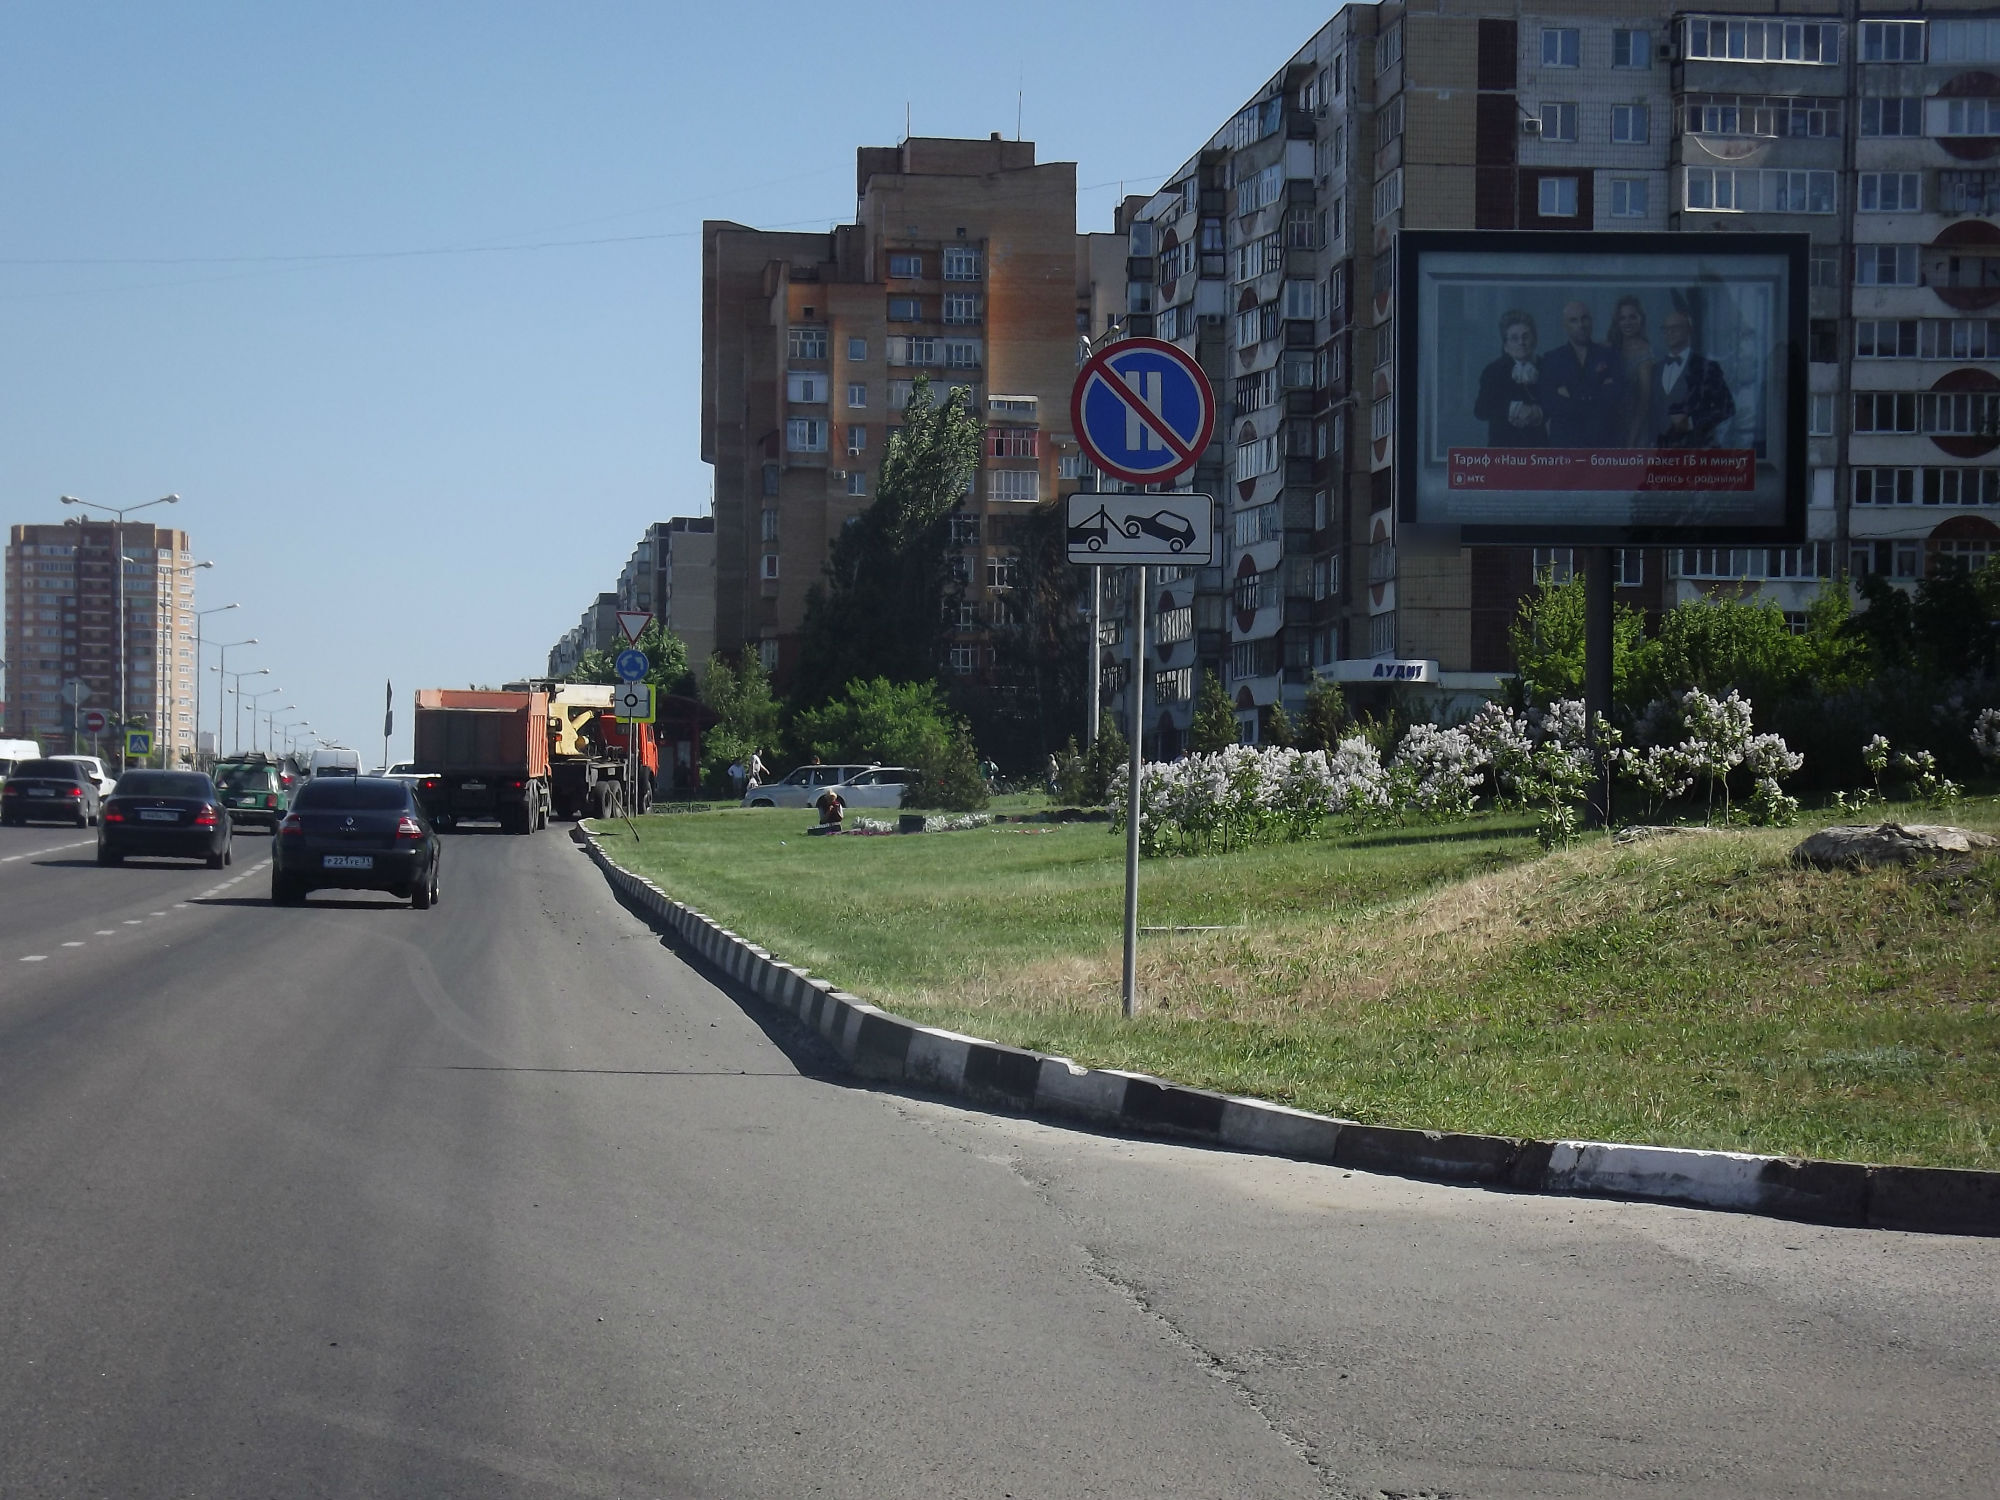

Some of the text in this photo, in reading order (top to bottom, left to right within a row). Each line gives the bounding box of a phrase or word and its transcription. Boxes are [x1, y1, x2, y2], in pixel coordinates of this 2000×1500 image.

[1454, 454, 1490, 468] Тариф
[1495, 455, 1527, 466] «Наш
[1530, 454, 1571, 466] Smart»
[1590, 454, 1643, 466] большой
[1647, 456, 1680, 466] пакет
[1683, 455, 1696, 466] ГБ
[1700, 457, 1707, 466] и
[1710, 457, 1748, 469] минут
[1646, 473, 1684, 484] Делись
[1695, 474, 1747, 485] родными!
